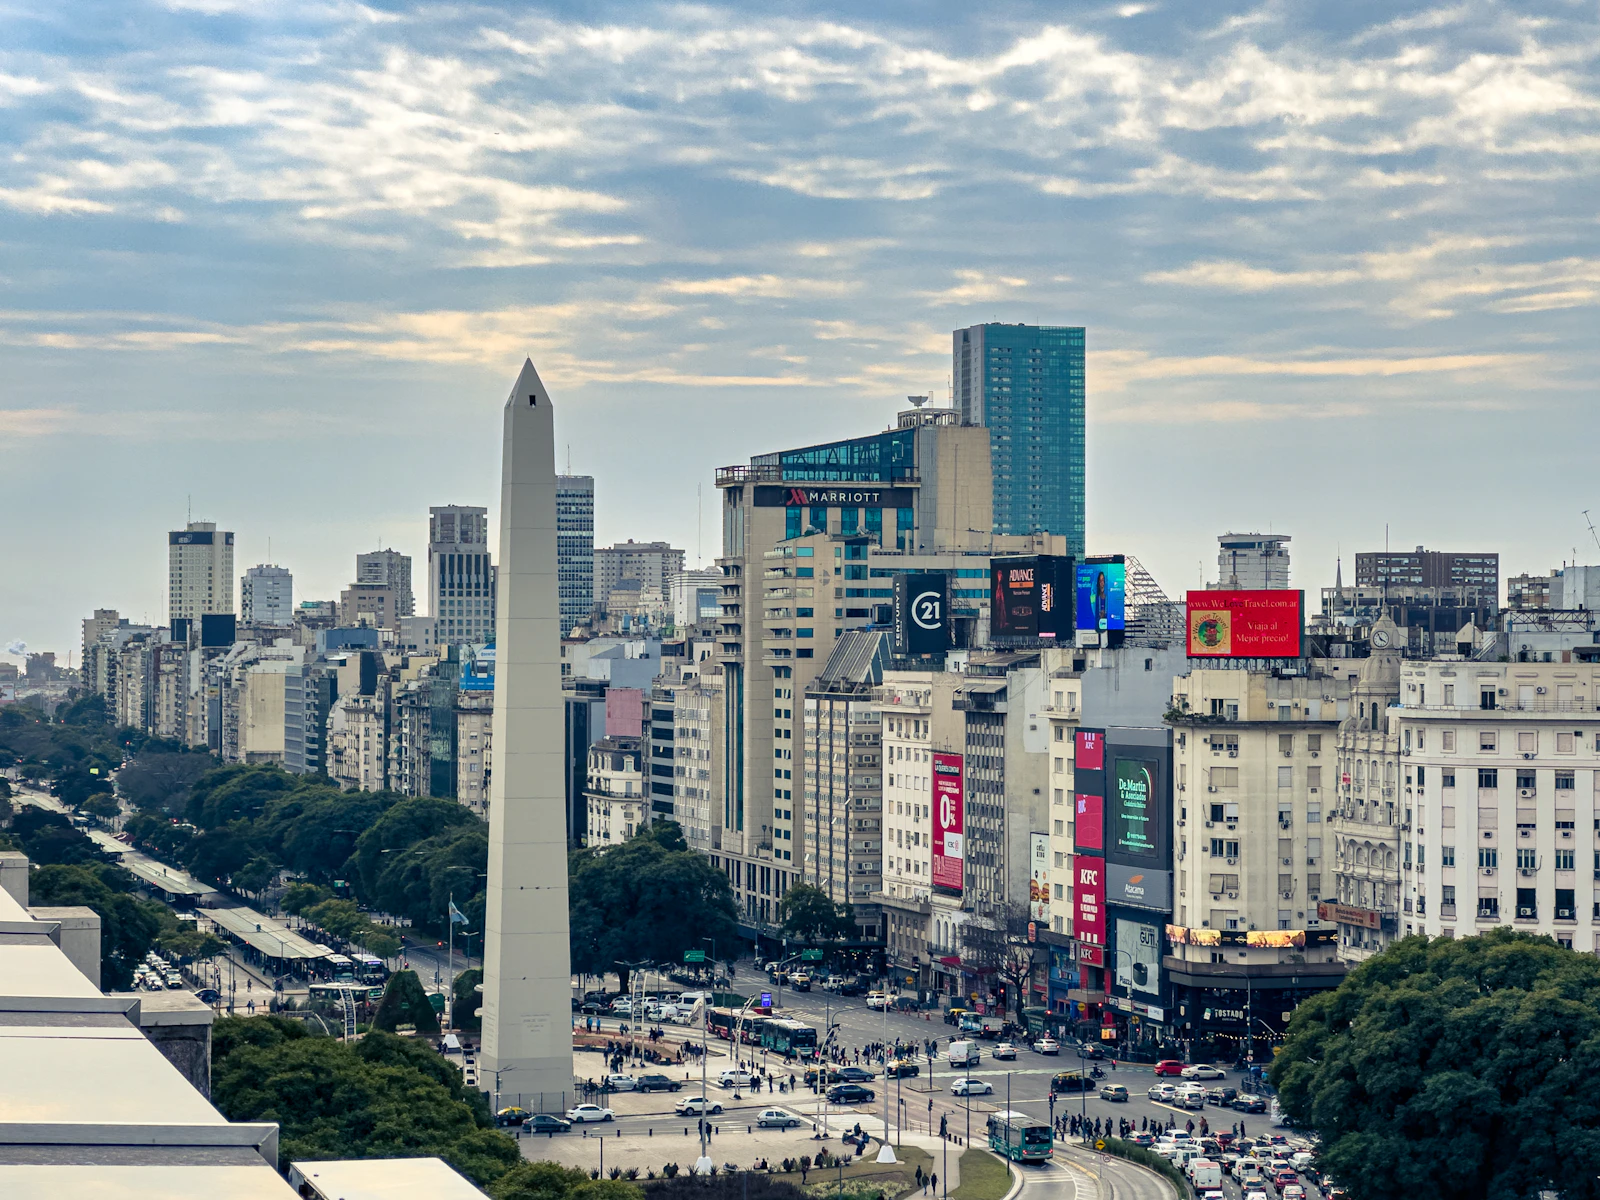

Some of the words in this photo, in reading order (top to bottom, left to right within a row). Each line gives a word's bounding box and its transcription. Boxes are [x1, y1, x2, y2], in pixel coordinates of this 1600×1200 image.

[809, 492, 880, 503] MARRIOTT
[1009, 568, 1034, 582] ADVANCE
[1188, 599, 1297, 608] www.WeLoveTravel.com.ar
[1247, 621, 1269, 631] Viaja
[1270, 621, 1278, 630] al
[1236, 633, 1259, 643] Mejor
[1261, 633, 1289, 643] precio!
[1085, 741, 1094, 749] KFC
[1080, 869, 1098, 886] KFC
[1124, 884, 1145, 895] Atacama
[1080, 948, 1093, 960] KFC
[1214, 1008, 1243, 1020] TOSTADO
